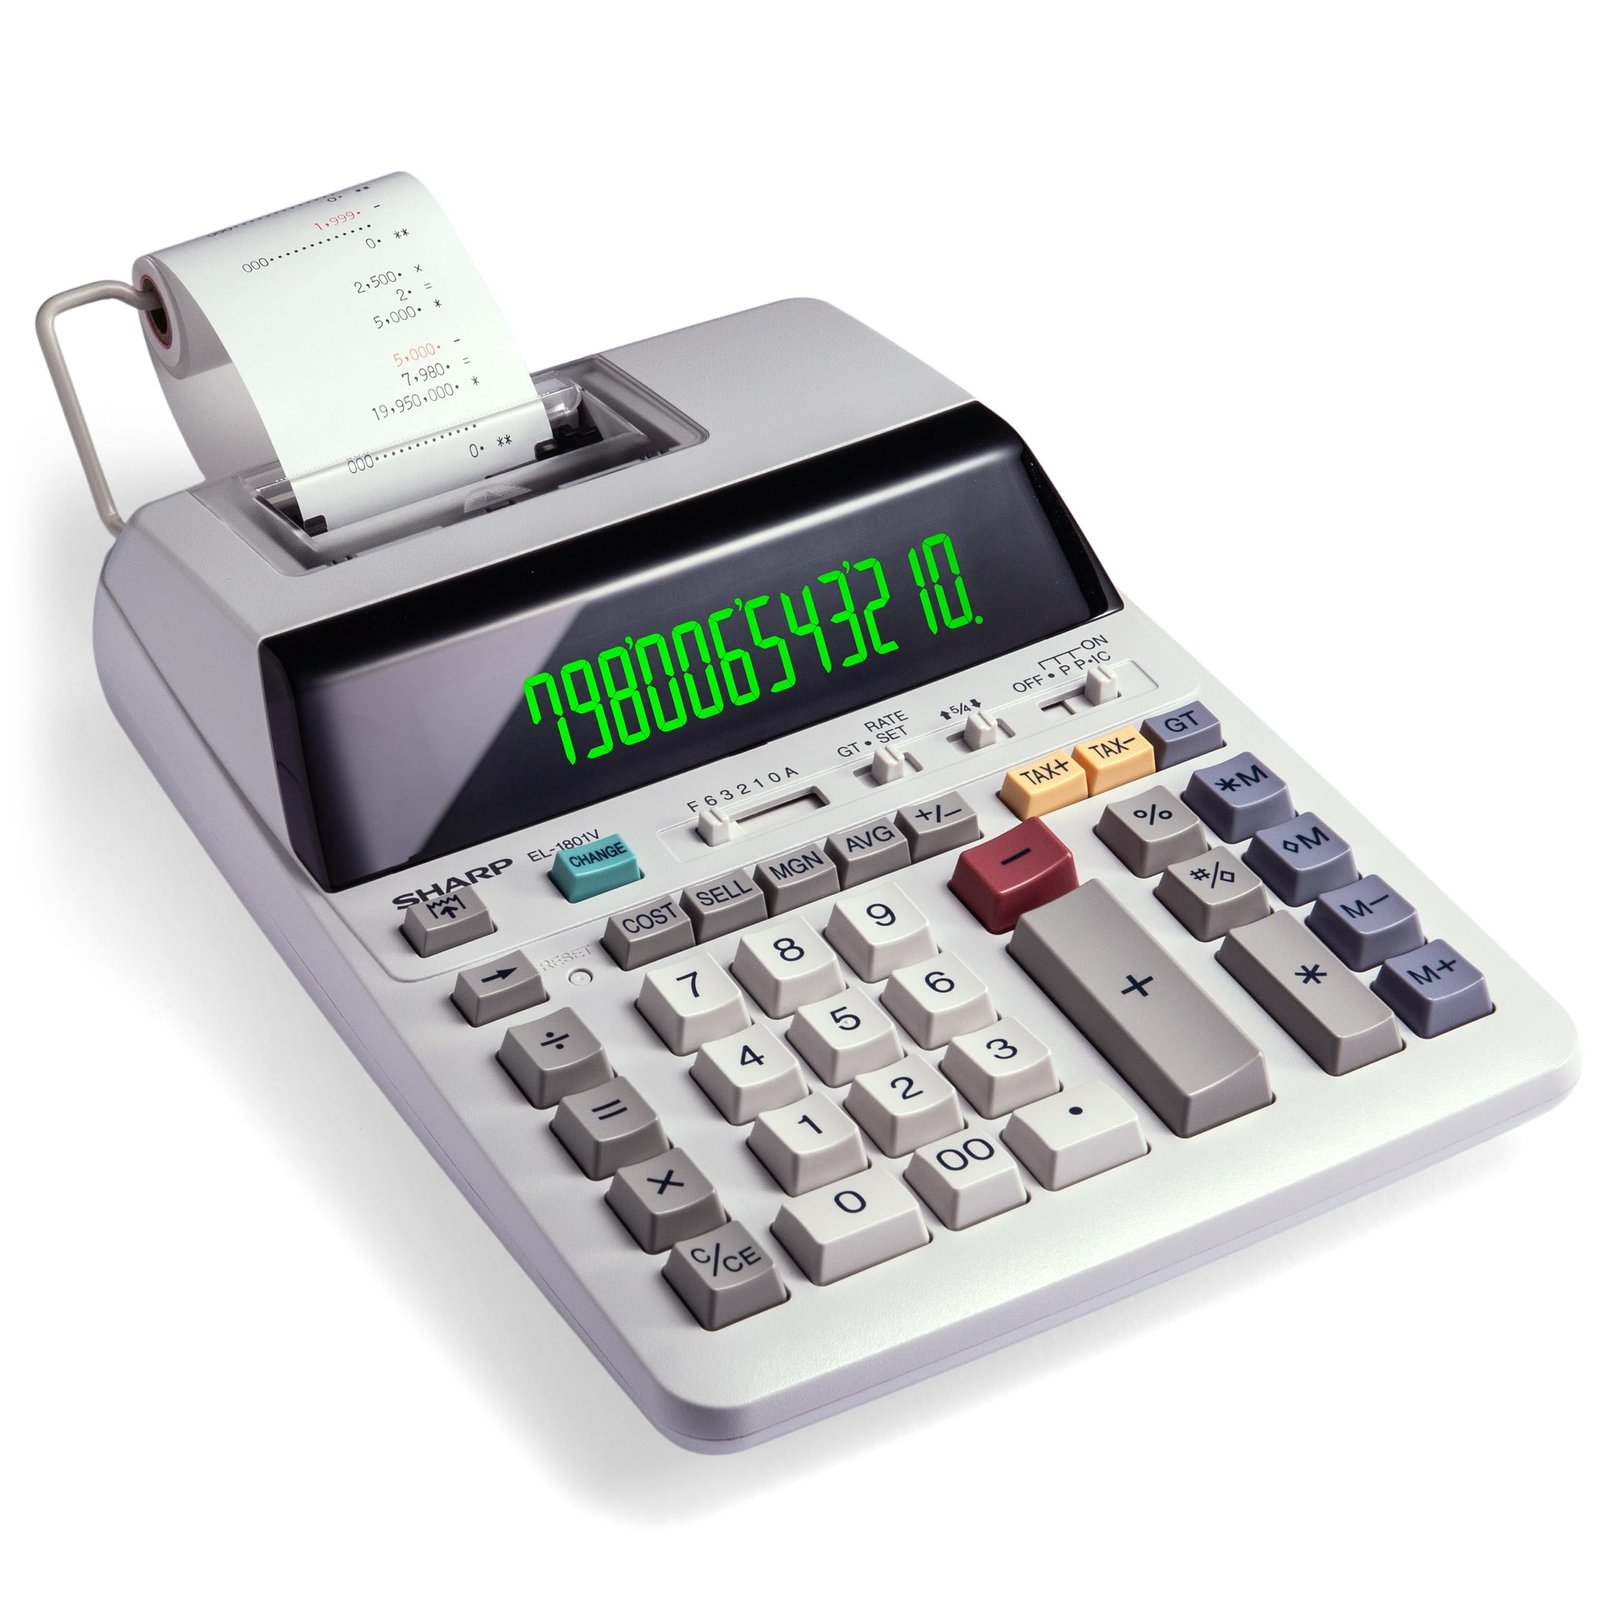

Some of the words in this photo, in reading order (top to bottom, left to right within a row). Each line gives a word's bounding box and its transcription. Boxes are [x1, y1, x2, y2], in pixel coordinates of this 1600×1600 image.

[1080, 634, 1109, 650] ON
[1012, 674, 1044, 693] OFF
[863, 710, 909, 733] RATE
[950, 702, 972, 715] 5/4
[1163, 711, 1201, 734] GT
[836, 742, 861, 759] GT
[876, 725, 909, 745] SET
[527, 828, 600, 863] EL-1801V
[845, 825, 896, 854] AVG
[568, 841, 628, 868] CHANGE
[768, 850, 825, 883] MGN
[392, 858, 513, 910] SHARP
[695, 878, 753, 909] SELL
[621, 902, 678, 936] COST
[865, 902, 898, 928] 9
[772, 936, 806, 963] 8
[675, 970, 702, 999] 7
[923, 970, 957, 994] 6
[829, 1005, 862, 1032] 5
[738, 1044, 766, 1070] 4
[985, 1036, 1019, 1061] 3
[890, 1075, 924, 1101] 2
[797, 1113, 824, 1136] 1
[935, 1137, 996, 1172] 00
[833, 1189, 868, 1215] 0
